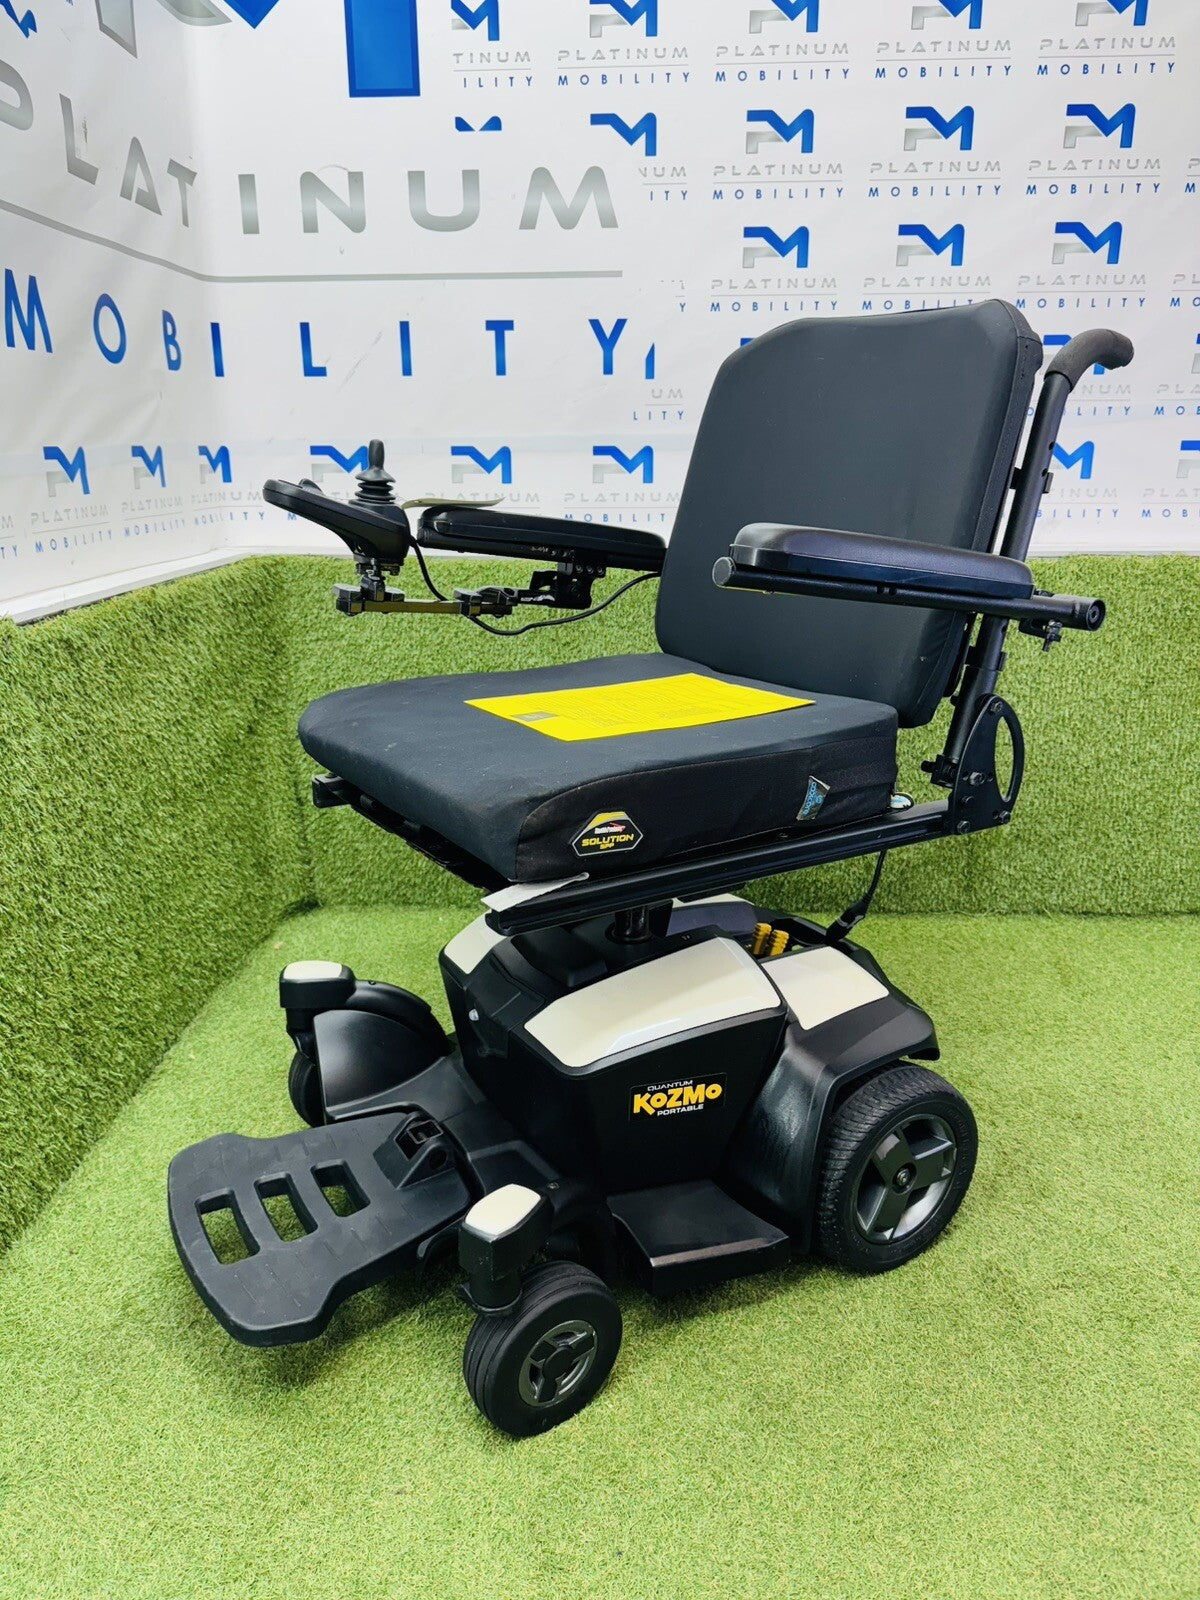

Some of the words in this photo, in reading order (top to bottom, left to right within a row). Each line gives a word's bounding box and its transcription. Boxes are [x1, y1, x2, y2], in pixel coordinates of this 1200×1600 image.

[716, 42, 849, 57] PLATINUM
[877, 39, 1012, 54] PLATINUM
[1040, 36, 1176, 51] PLATINUM
[453, 51, 531, 64] TINUM
[558, 47, 689, 61] PLATINUM
[715, 68, 850, 82] MOBILITY
[875, 65, 1012, 78] MOBILITY
[1037, 62, 1176, 76] MOBILITY
[463, 76, 533, 88] ILITY
[558, 72, 690, 86] MOBILITY
[713, 163, 843, 176] PLATINUM
[870, 160, 1001, 174] PLATINUM
[1028, 158, 1161, 171] PLATINUM
[712, 187, 843, 200] MOBILITY
[868, 185, 1001, 197] MOBILITY
[1026, 182, 1161, 195] MOBILITY
[711, 277, 837, 290] PLATINUM
[863, 275, 991, 288] PLATINUM
[1017, 274, 1147, 286] PLATINUM
[710, 301, 838, 312] MOBILITY
[1015, 297, 1146, 309] MOBILITY
[4, 268, 628, 378] MOBILITY
[31, 504, 109, 525] PLATINUM
[35, 529, 113, 553] MOBILITY
[581, 833, 635, 847] SOLUTION
[647, 1080, 693, 1092] QUANTUM
[657, 1104, 704, 1116] PORTABLE
